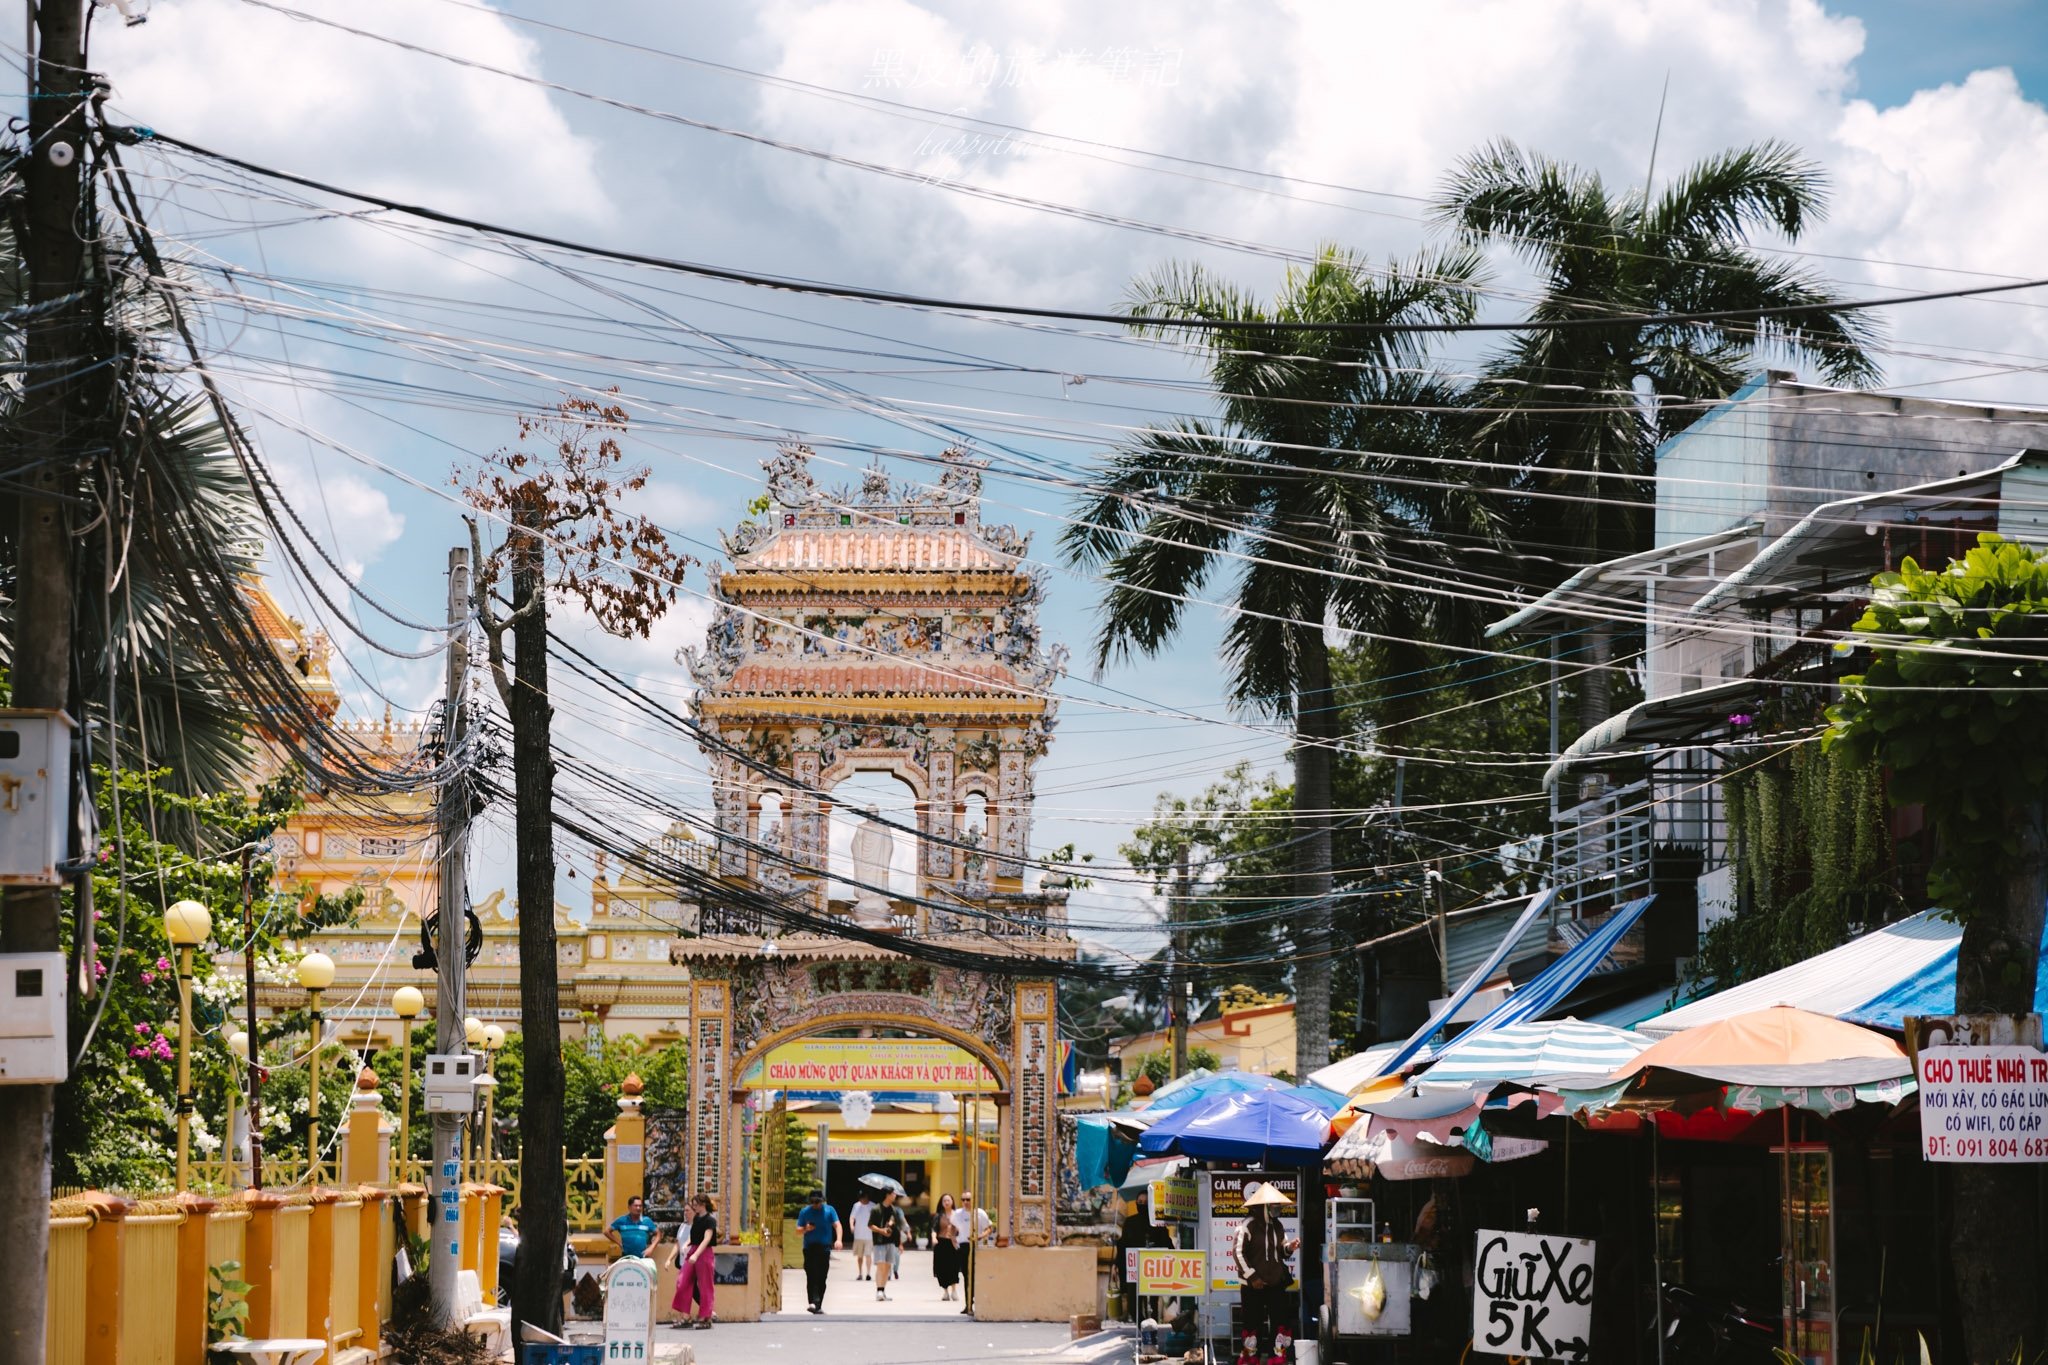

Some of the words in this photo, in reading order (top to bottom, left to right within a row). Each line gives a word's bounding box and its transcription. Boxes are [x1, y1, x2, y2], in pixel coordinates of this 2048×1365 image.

[770, 1060, 796, 1079] CHÀO
[799, 1060, 826, 1079] MỪNG
[828, 1060, 849, 1082] QUÝ
[851, 1065, 878, 1082] QUAN
[880, 1061, 914, 1080] KHÁCH
[917, 1062, 929, 1079] VÀ
[933, 1061, 952, 1084] QUÝ
[1924, 1058, 1953, 1083] CHO
[1958, 1054, 1992, 1083] THUÊ
[1997, 1054, 2026, 1083] NHÀ
[1926, 1089, 1947, 1108] MỚI
[1952, 1089, 1976, 1110] XÂY,
[1981, 1089, 1997, 1108] CÓ
[2002, 1089, 2025, 1108] GÁC
[1946, 1113, 1961, 1131] CÓ
[1966, 1116, 1994, 1134] WIFI,
[1999, 1112, 2015, 1131] CÓ
[2019, 1112, 2041, 1131] CÁP
[1929, 1136, 1951, 1156] ĐT:
[1957, 1139, 1982, 1157] 091
[1989, 1138, 2018, 1157] 804
[2024, 1138, 2048, 1157] 687
[1214, 1179, 1225, 1190] CÀ
[1227, 1179, 1242, 1190] PHÊ
[1143, 1256, 1176, 1278] GIỮ
[1180, 1260, 1202, 1279] XE
